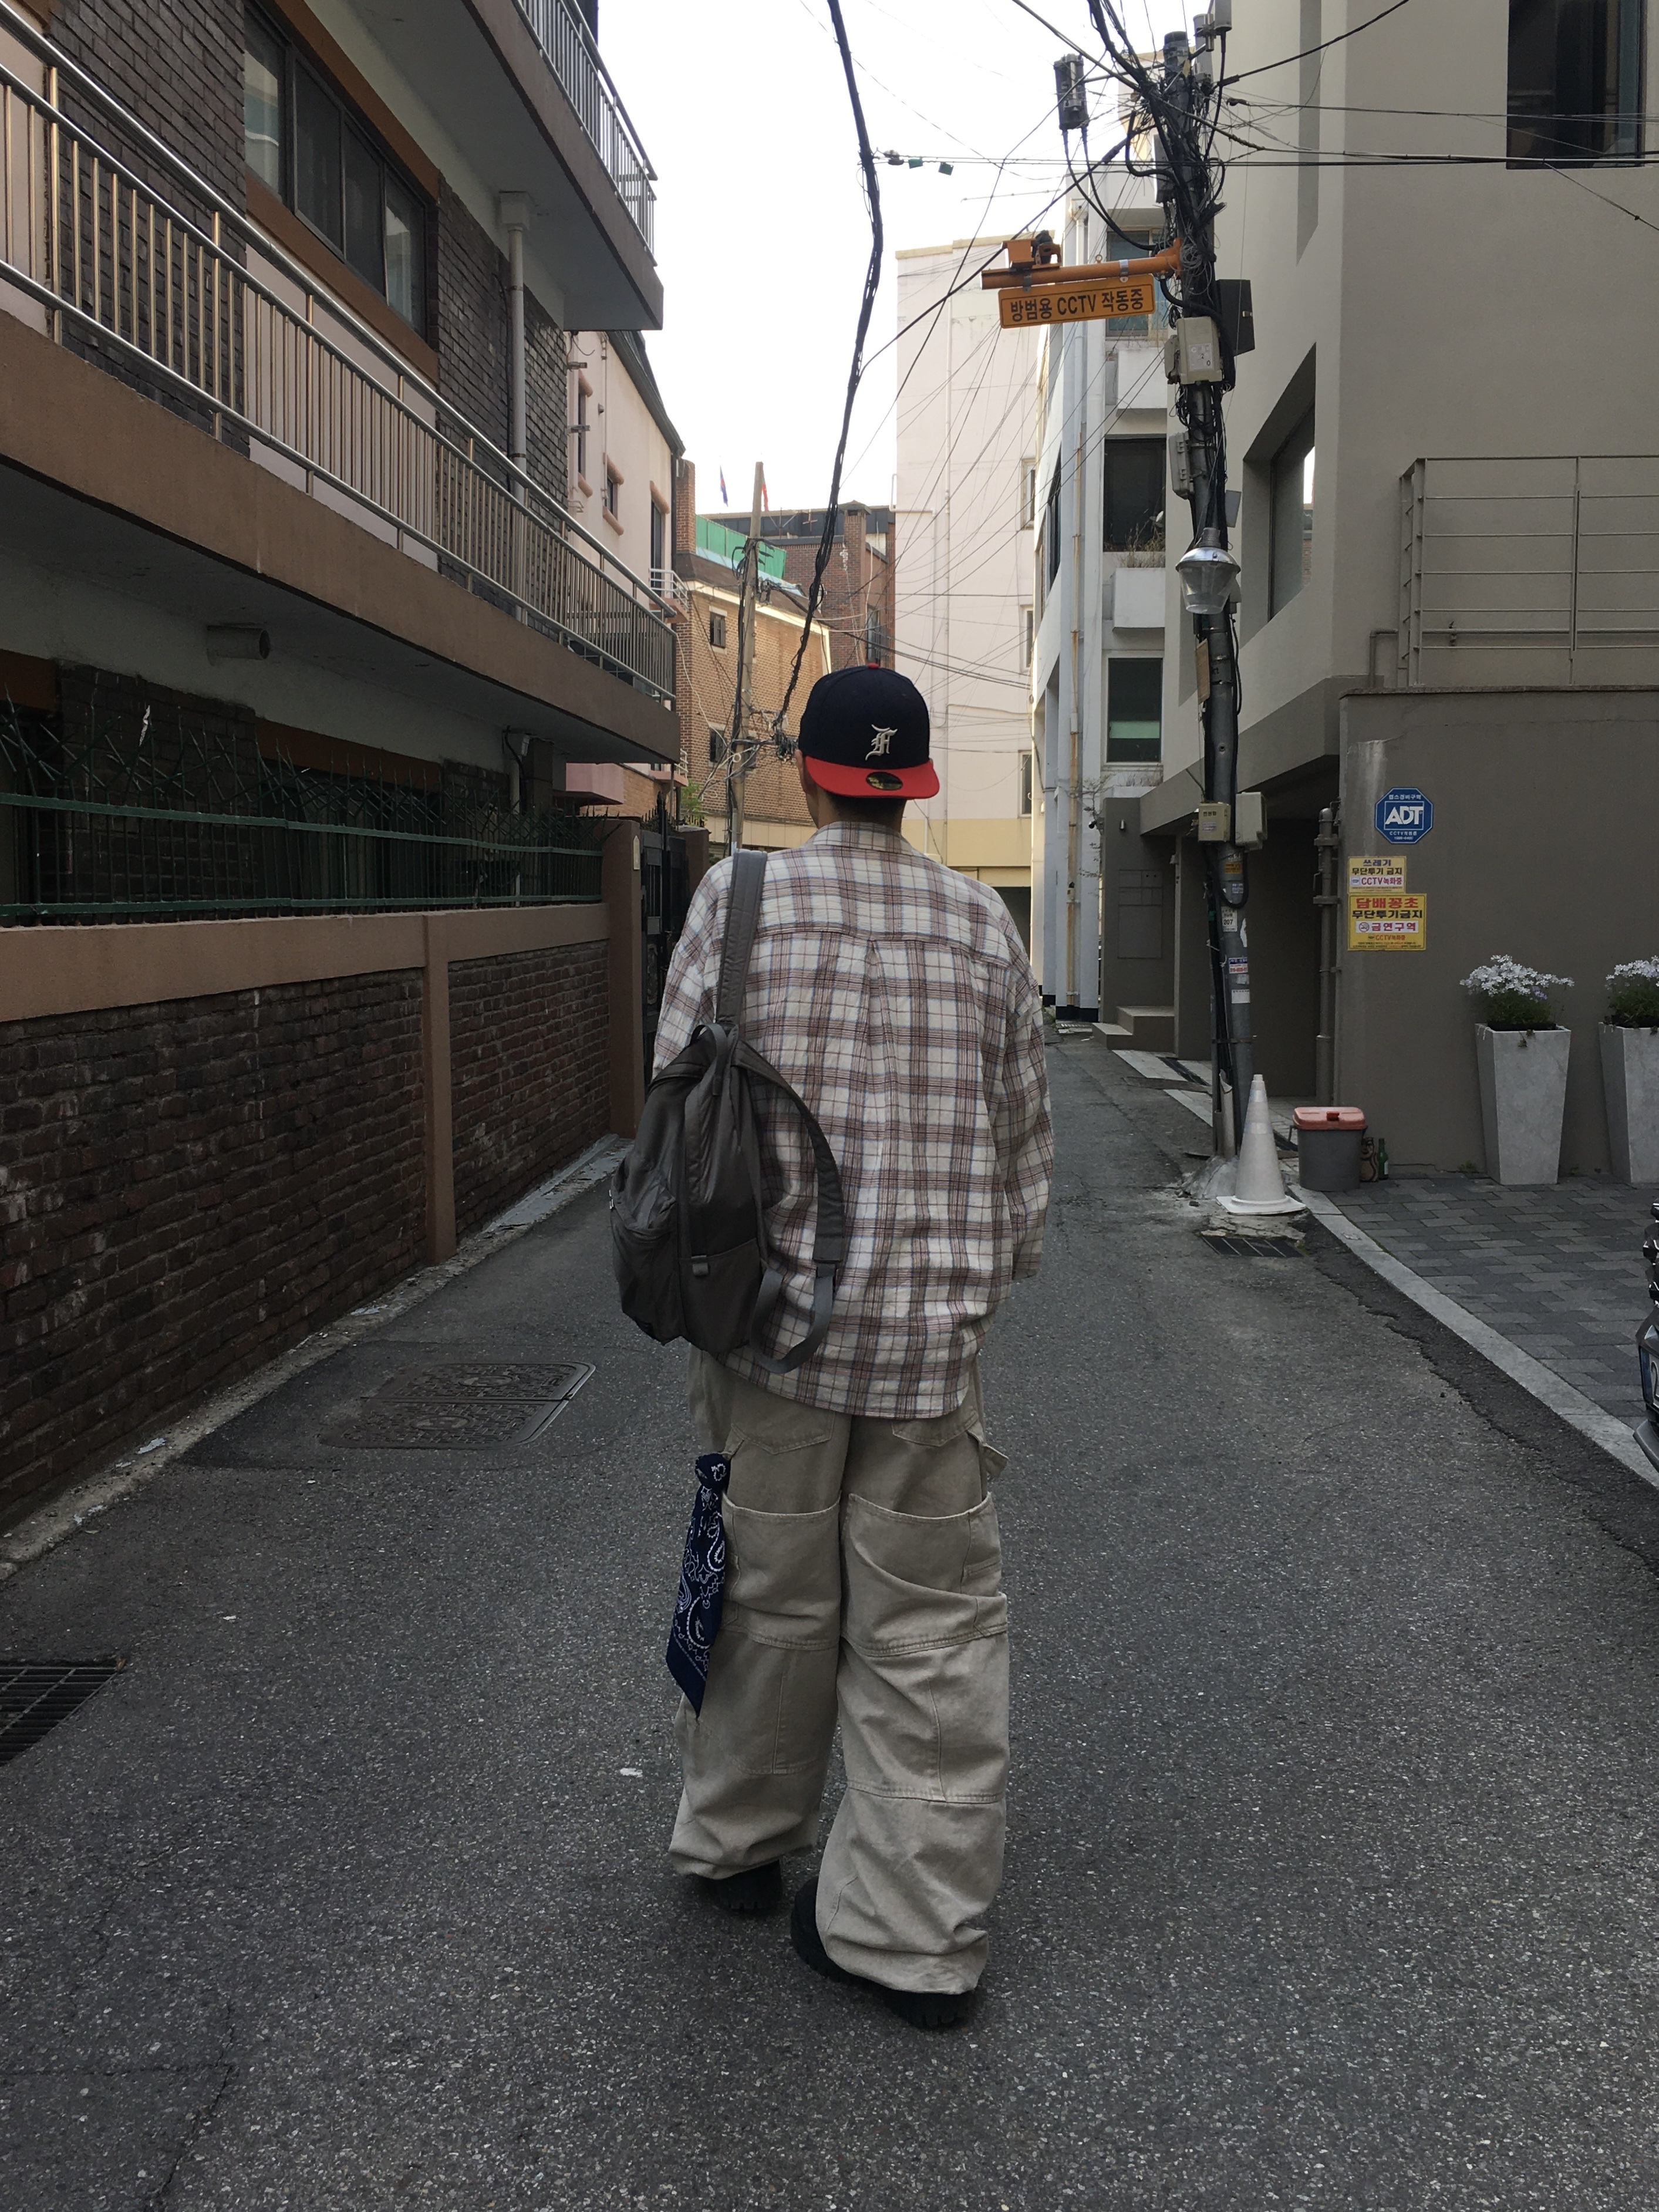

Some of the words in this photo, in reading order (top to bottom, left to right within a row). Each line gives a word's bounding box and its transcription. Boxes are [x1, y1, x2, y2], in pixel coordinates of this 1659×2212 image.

[1010, 298, 1053, 322] 방범용
[1057, 294, 1096, 316] CCTV
[1101, 288, 1144, 312] 작동중
[1385, 805, 1424, 825] ADT
[1361, 877, 1402, 885] CCTV녹화중
[1356, 897, 1419, 909] 담배꽁초
[1352, 910, 1422, 919] 무단투기금지
[1371, 922, 1416, 932] 금연구역
